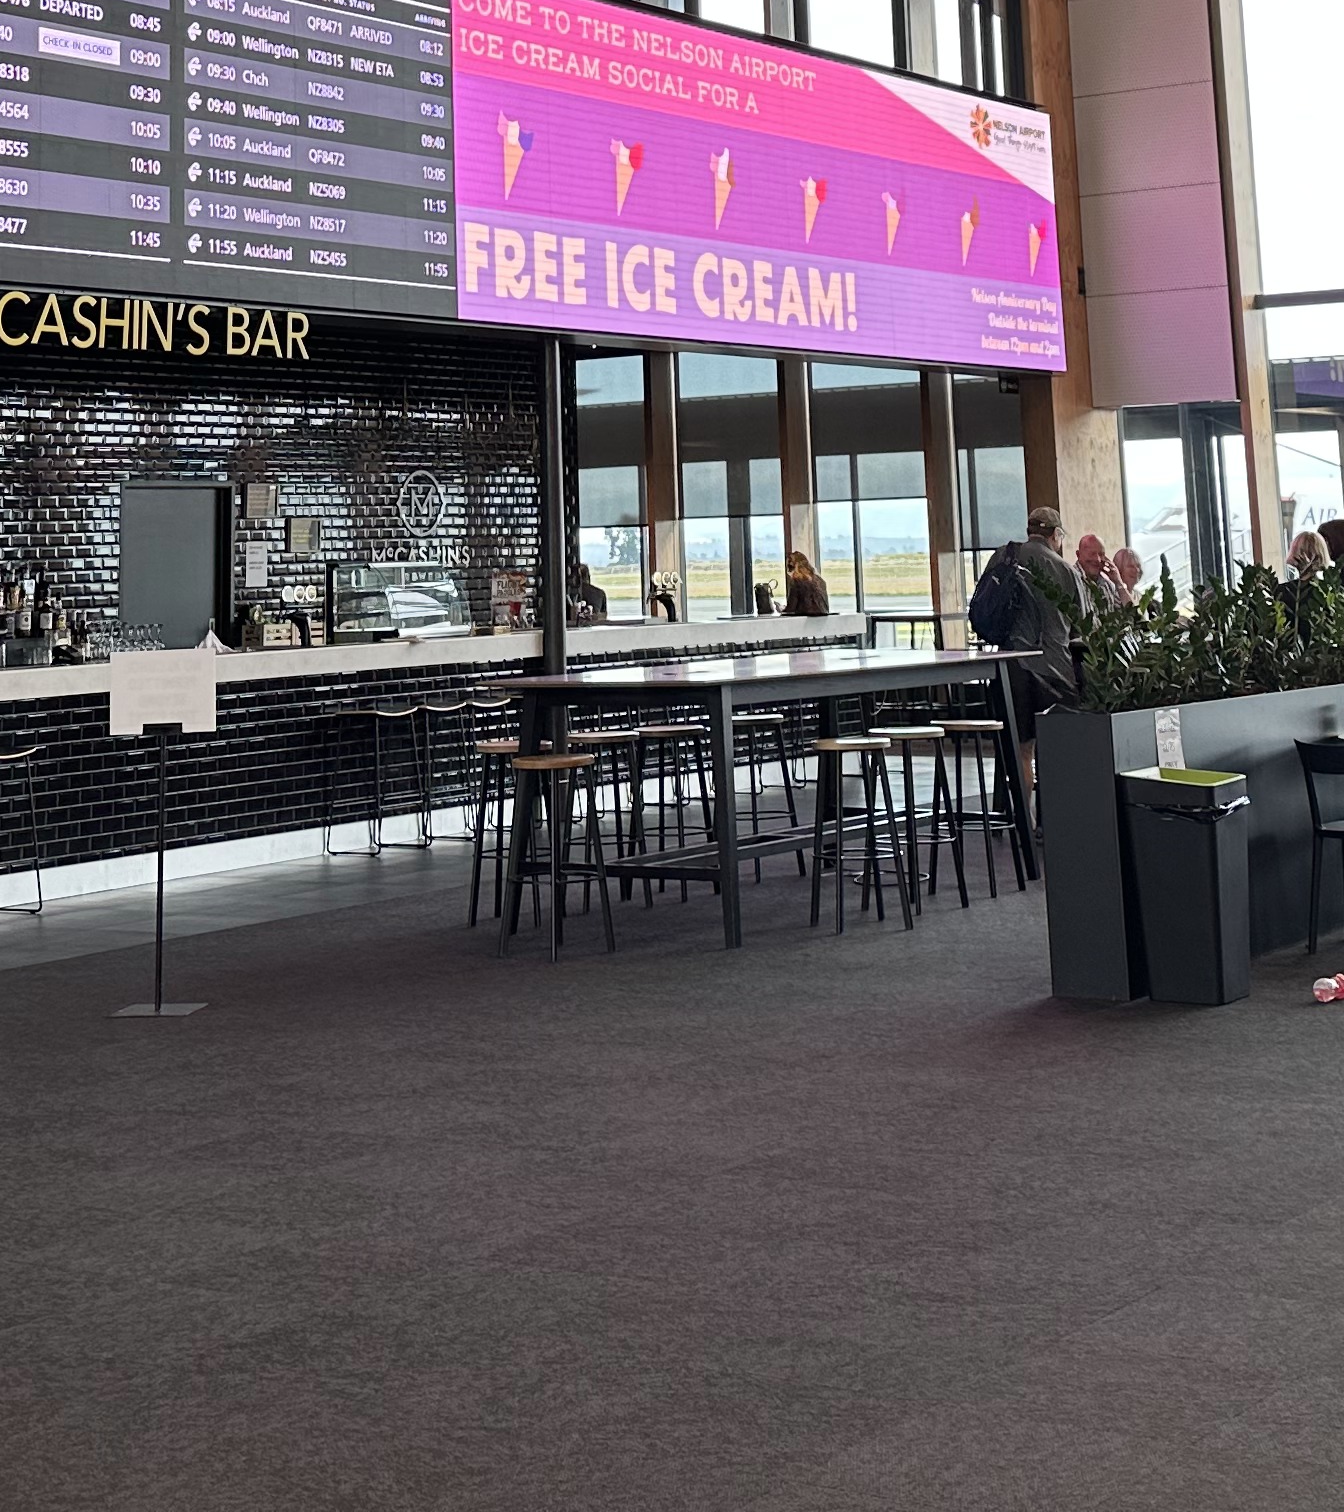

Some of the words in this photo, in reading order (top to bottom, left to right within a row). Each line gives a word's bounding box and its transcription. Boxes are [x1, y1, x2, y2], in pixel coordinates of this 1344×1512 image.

[130, 14, 161, 32] 08:45
[349, 0, 375, 12] STATUS
[242, 1, 290, 24] Auckland
[307, 16, 342, 35] QF8471
[350, 26, 392, 45] ARRIVED
[420, 40, 443, 56] 08:12
[43, 36, 68, 47] CHECK
[72, 40, 80, 49] IN
[83, 42, 113, 56] CLOSED
[130, 49, 161, 68] 09:00
[207, 29, 236, 46] 09:00
[242, 35, 299, 60] Wellington
[307, 49, 344, 68] NZ8315
[351, 57, 376, 73] NEW
[376, 63, 394, 77] ETA
[420, 71, 444, 87] 08:53
[539, 6, 571, 34] TO
[578, 15, 626, 47] THE
[632, 29, 724, 70] NELSON
[729, 53, 817, 92] AIRPORT
[459, 28, 505, 60] ICE
[512, 40, 601, 81] CREAM
[608, 62, 692, 99] SOCIAL
[697, 81, 740, 110] FOR
[745, 94, 759, 114] A
[129, 86, 161, 103] 09:30
[207, 63, 236, 81] 09:30
[243, 70, 269, 86] Chch
[420, 103, 445, 118] 09:30
[130, 121, 161, 138] 10:05
[207, 98, 236, 115] 09:40
[243, 104, 300, 128] Wellington
[421, 134, 445, 150] 09:40
[993, 120, 1017, 134] NELSON
[1019, 126, 1045, 140] AIRPORT
[130, 157, 161, 175] 10:10
[208, 133, 236, 150] 10:05
[243, 138, 291, 158] Auckland
[309, 149, 345, 167] QF8472
[423, 166, 446, 181] 10:05
[130, 194, 161, 211] 10:35
[208, 168, 236, 184] 11:15
[243, 174, 292, 193] Auckland
[423, 198, 446, 213] 11:15
[130, 230, 161, 248] 11:45
[208, 204, 237, 220] 11:20
[244, 208, 301, 229] Wellington
[310, 216, 346, 233] NZ8517
[424, 231, 447, 245] 11:20
[208, 239, 237, 255] 11:55
[244, 243, 293, 261] Auckland
[310, 250, 347, 267] NZ5455
[424, 263, 448, 277] 11:55
[464, 222, 587, 305] FREE
[606, 241, 677, 315] ICE
[693, 252, 857, 332] CREAM!
[971, 288, 996, 305] Nelson
[227, 306, 310, 360] BAR
[988, 312, 1016, 329] Outside
[1017, 317, 1028, 330] the
[1028, 319, 1058, 334] terminal
[1302, 506, 1338, 525] AIR
